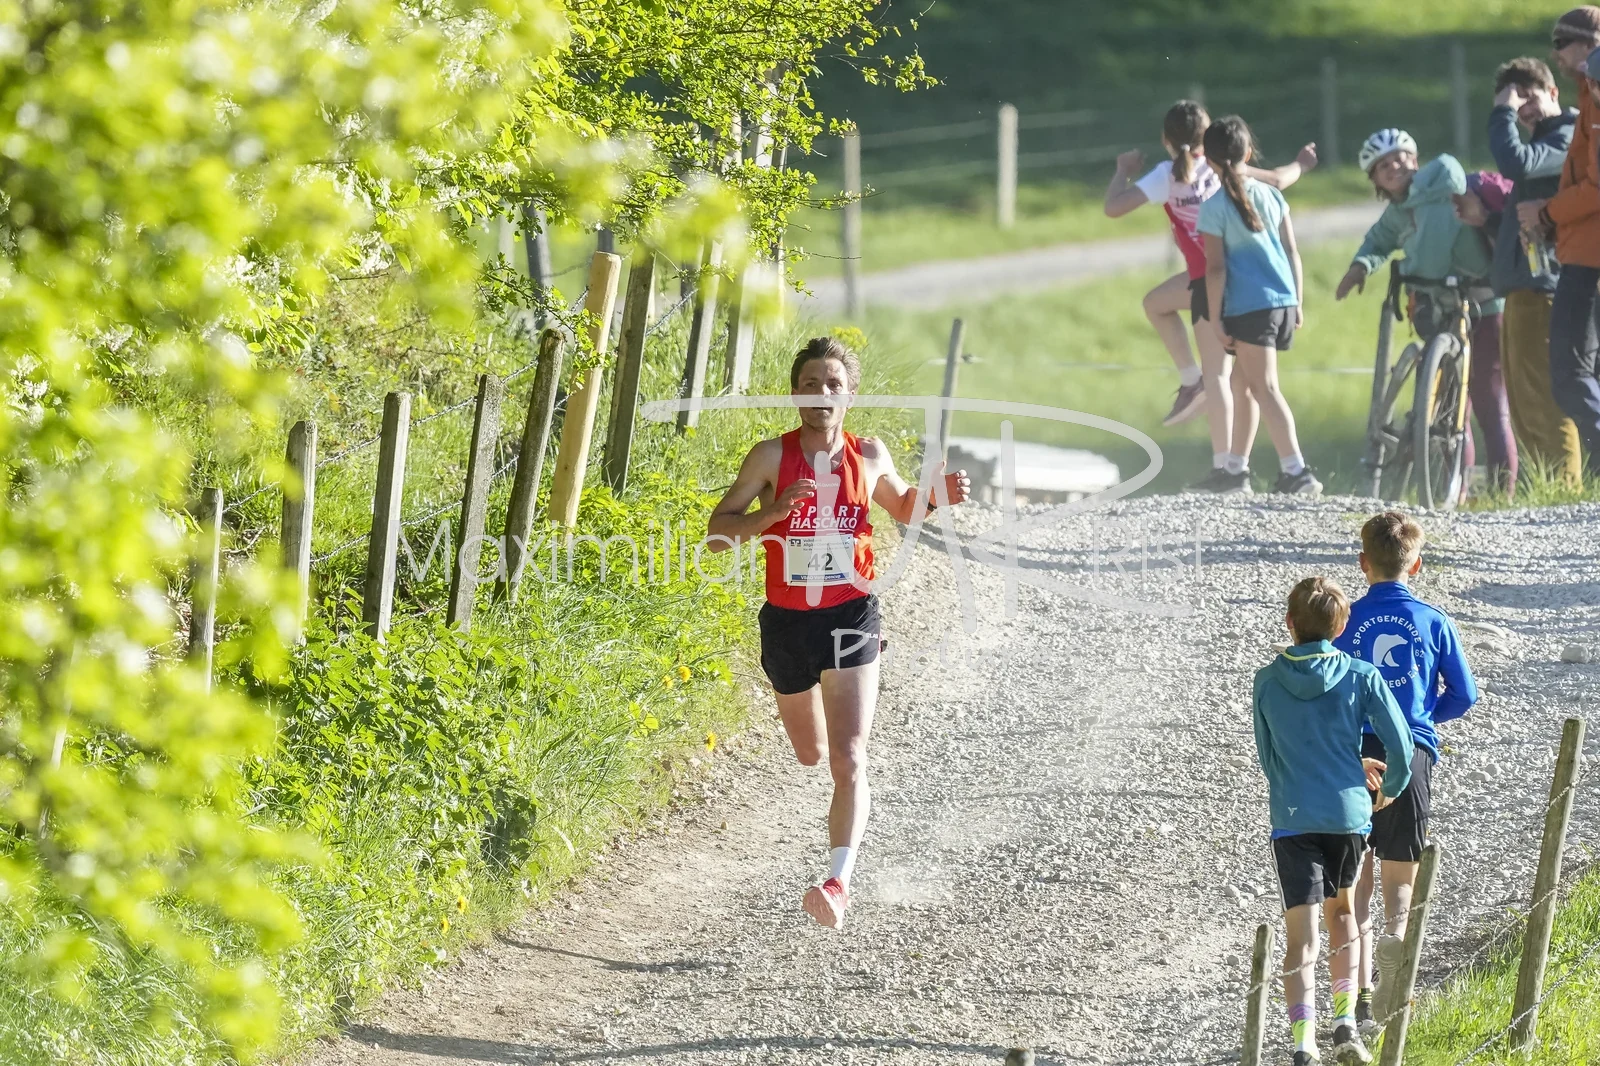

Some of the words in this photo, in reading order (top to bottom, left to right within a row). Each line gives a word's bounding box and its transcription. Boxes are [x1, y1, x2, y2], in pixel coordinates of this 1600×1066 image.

[793, 505, 861, 517] SPORT
[789, 517, 858, 529] HASCHKO
[808, 553, 833, 571] 42
[1352, 615, 1422, 646] SPORTGEMEINDE
[1352, 650, 1361, 658] 18
